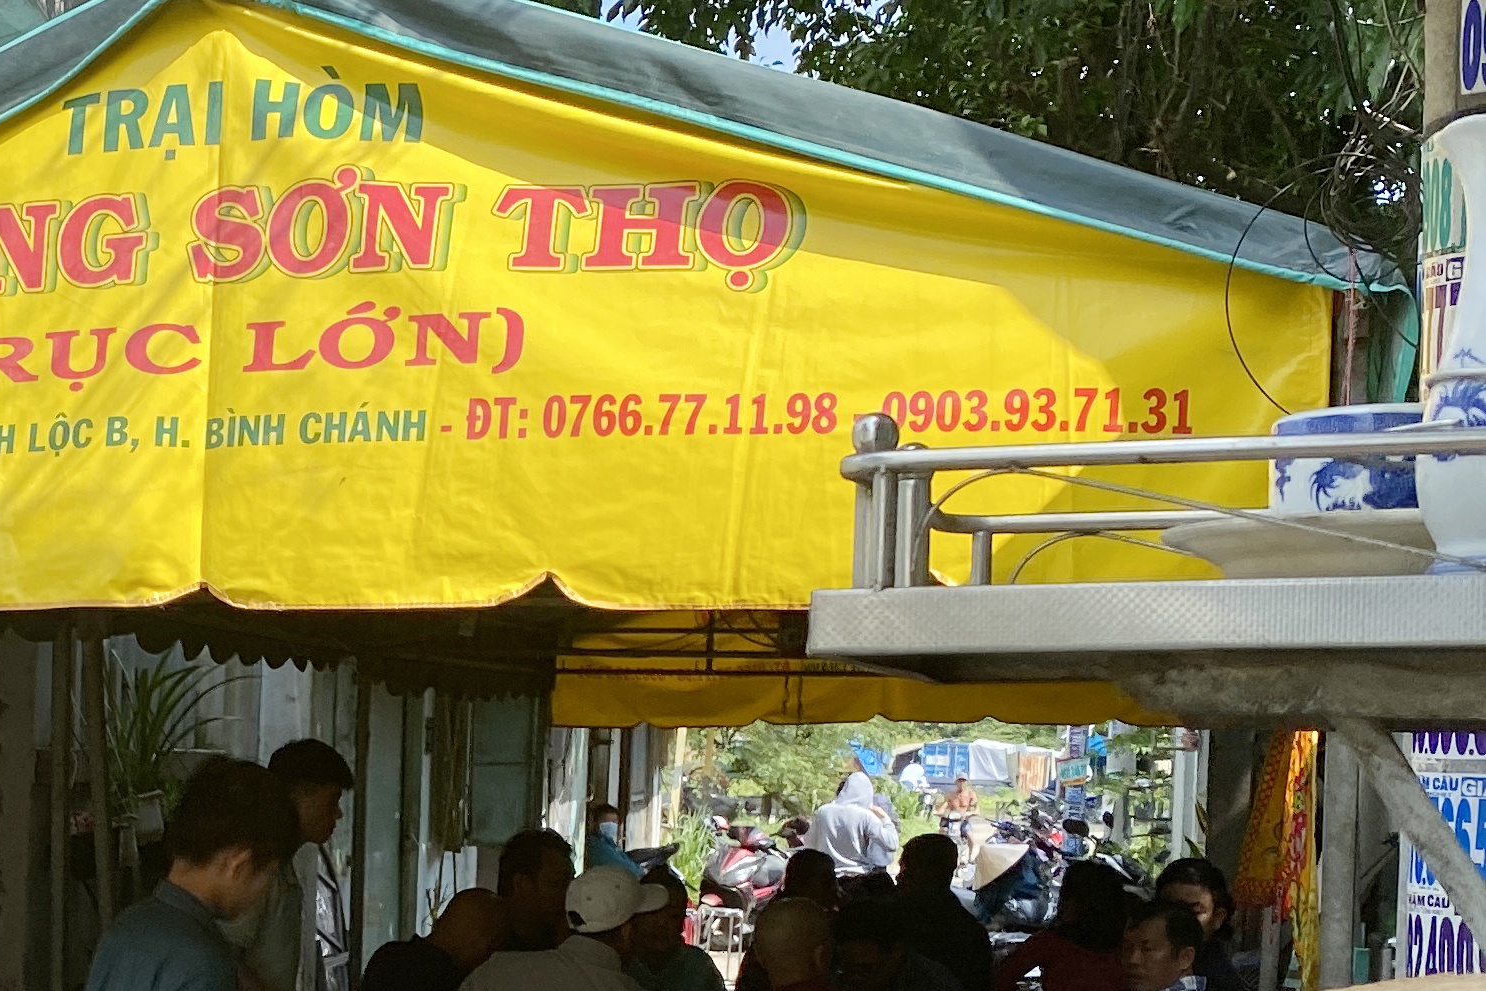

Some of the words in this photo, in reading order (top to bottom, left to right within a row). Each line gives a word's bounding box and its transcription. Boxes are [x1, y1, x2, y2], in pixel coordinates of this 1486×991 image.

[63, 79, 223, 161] TRẠI
[251, 65, 424, 144] HÒM
[187, 164, 467, 286] SƠN
[491, 178, 807, 293] THỌ
[242, 300, 525, 374] LỚN)
[28, 412, 93, 457] LỘC
[106, 415, 140, 455] B,
[154, 415, 191, 450] H.
[204, 408, 285, 451] BÌNH
[299, 401, 427, 445] CHÁNH
[466, 396, 531, 441] ĐT:
[542, 391, 838, 437] 0766.77.11.98
[881, 387, 1194, 436] 0903.93.71.31
